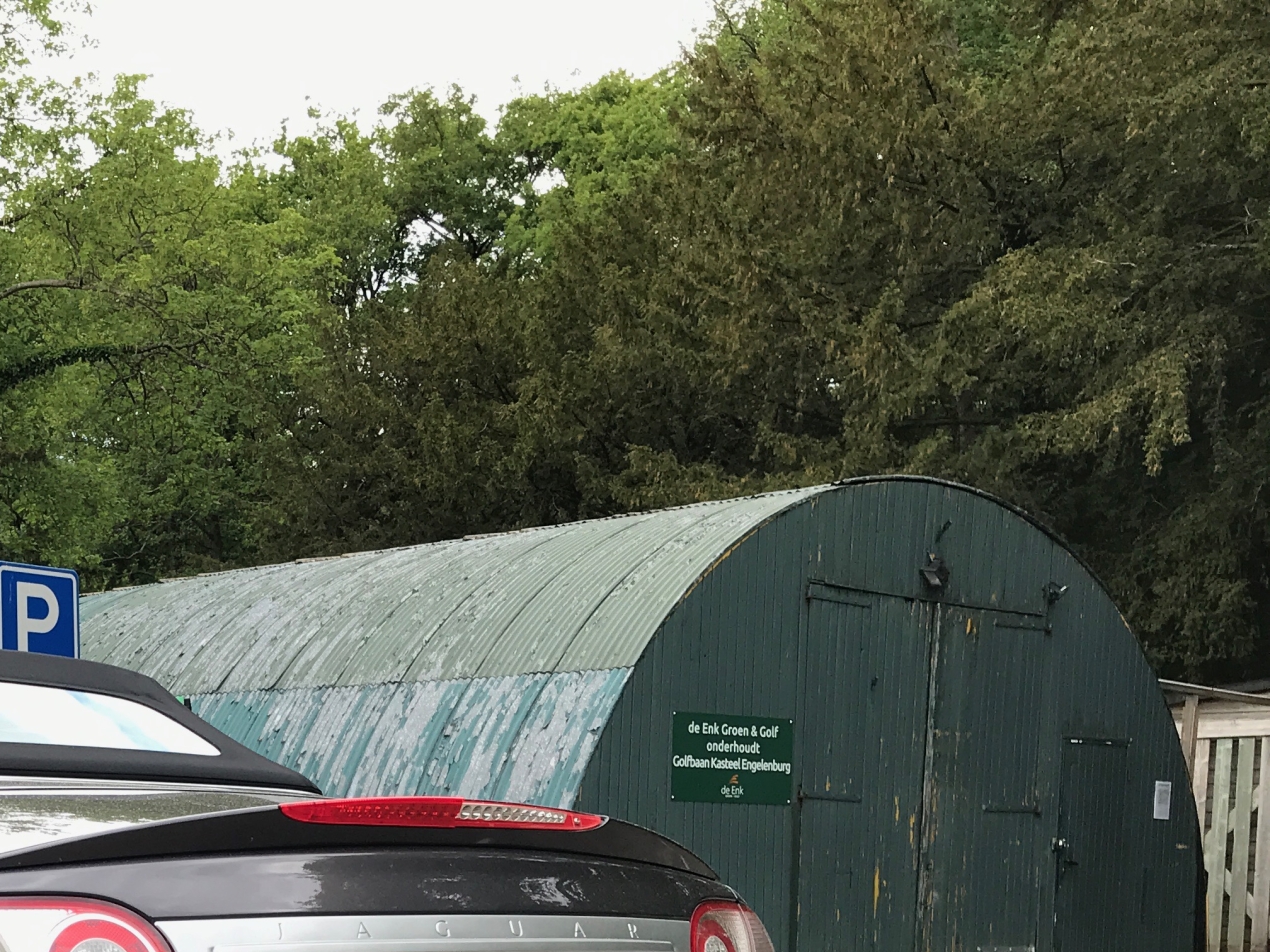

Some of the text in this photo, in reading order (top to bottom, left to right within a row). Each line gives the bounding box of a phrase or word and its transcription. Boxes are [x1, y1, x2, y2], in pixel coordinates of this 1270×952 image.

[17, 581, 59, 652] P
[688, 721, 779, 738] de Enk Groen & Golf
[706, 740, 761, 754] onderhoudt
[672, 754, 791, 775] Golfbaan Kasteel Engelenburg
[720, 784, 744, 795] de Enk
[277, 919, 640, 940] JAGUAR
